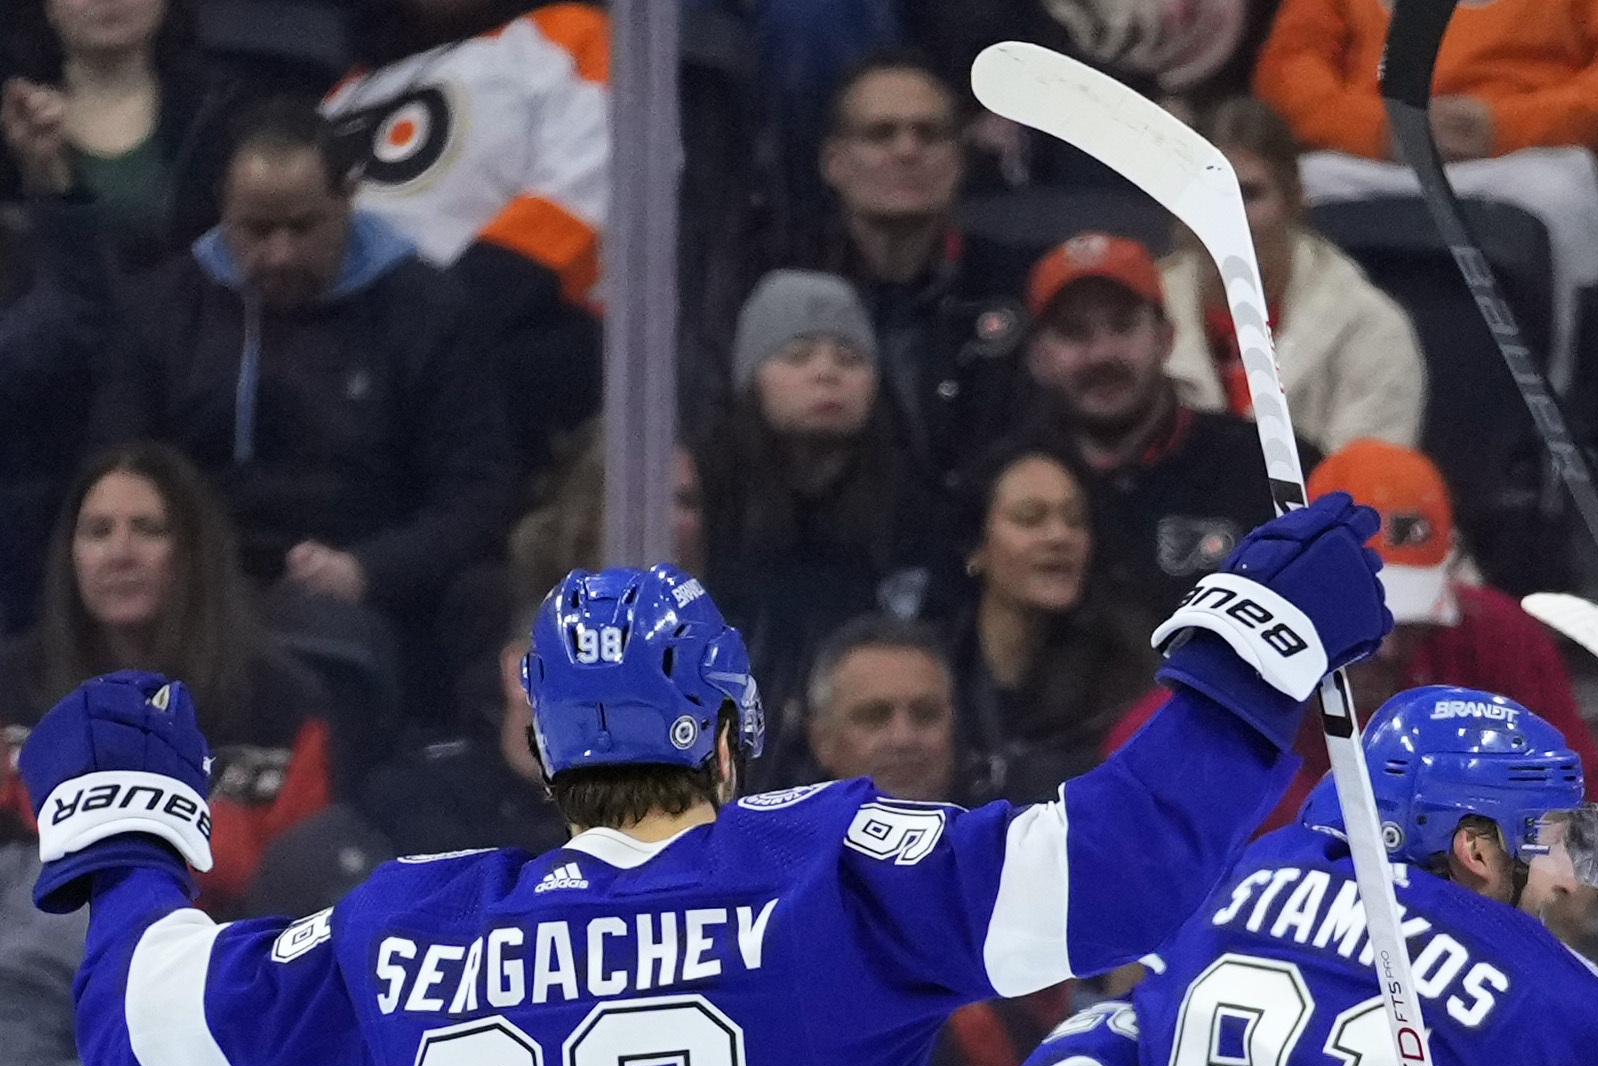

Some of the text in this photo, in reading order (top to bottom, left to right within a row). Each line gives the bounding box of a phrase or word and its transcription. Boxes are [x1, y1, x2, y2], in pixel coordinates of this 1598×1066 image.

[576, 625, 623, 664] 98
[1430, 701, 1520, 722] BRANDT
[534, 877, 589, 893] adidas
[376, 898, 780, 1015] SERGACHEV
